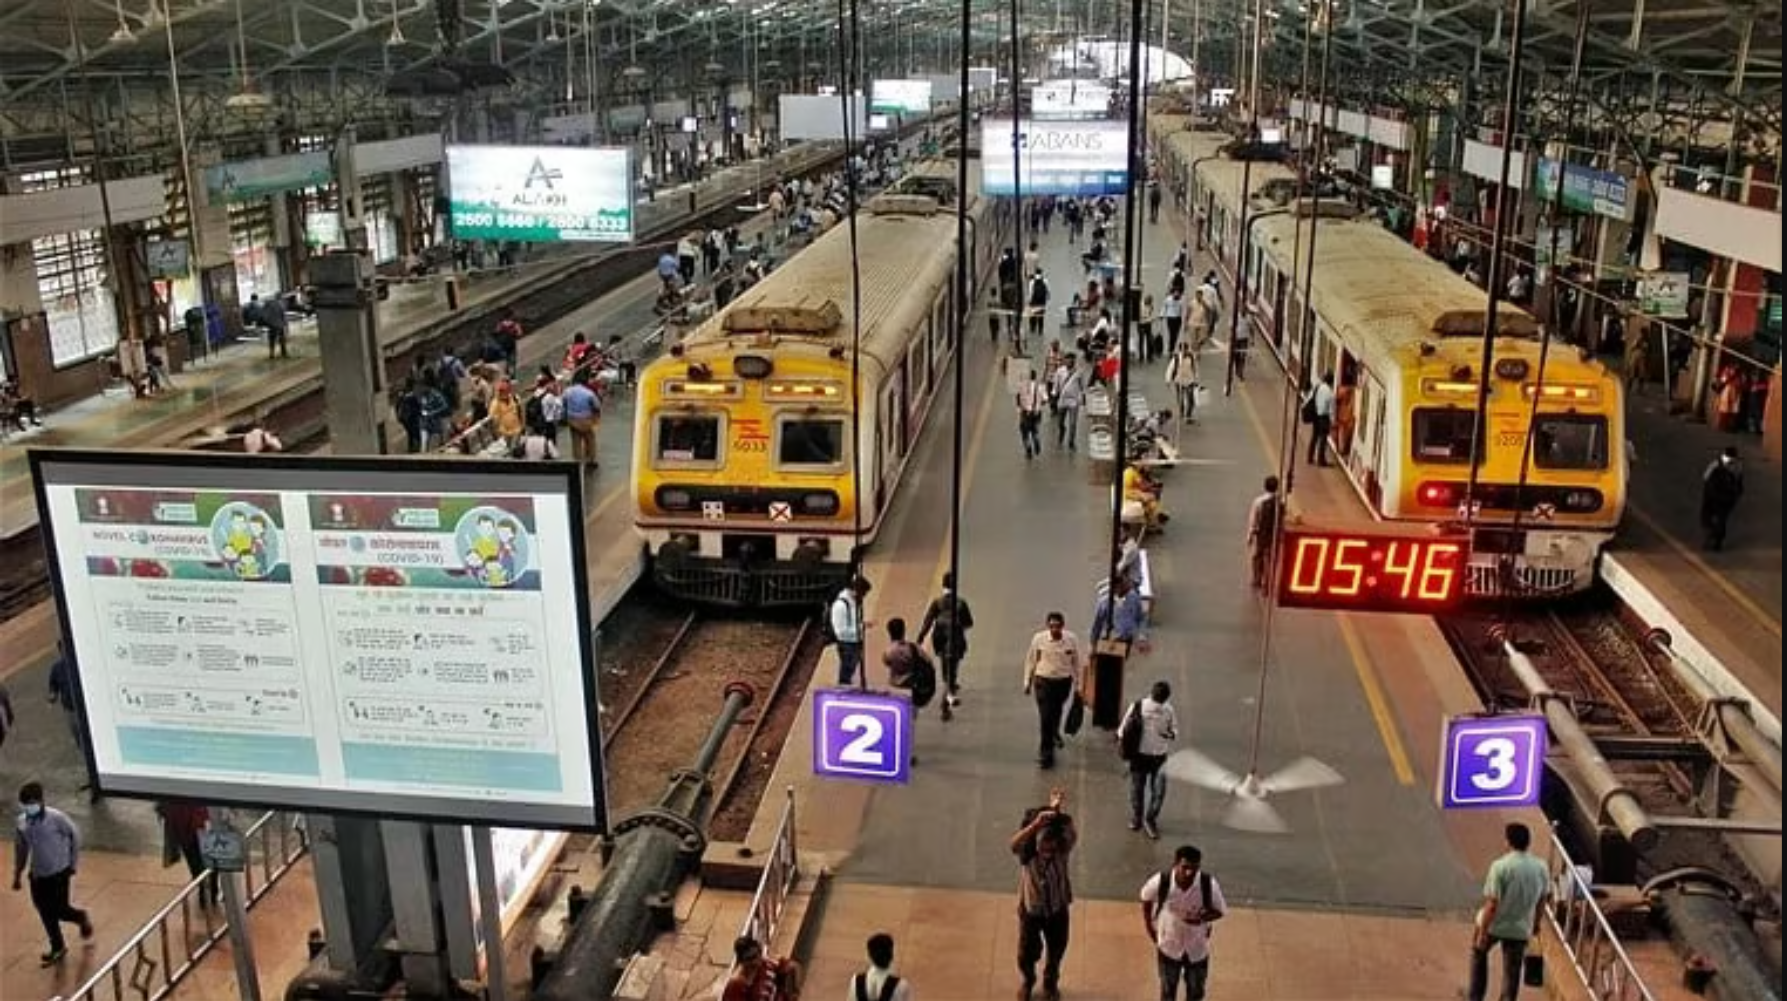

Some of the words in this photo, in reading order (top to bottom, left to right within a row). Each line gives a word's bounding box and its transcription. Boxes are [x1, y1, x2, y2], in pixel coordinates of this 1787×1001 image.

[1031, 132, 1103, 150] ABANS
[1289, 537, 1459, 600] 05:46
[840, 714, 883, 765] 2
[1470, 737, 1517, 790] 3
